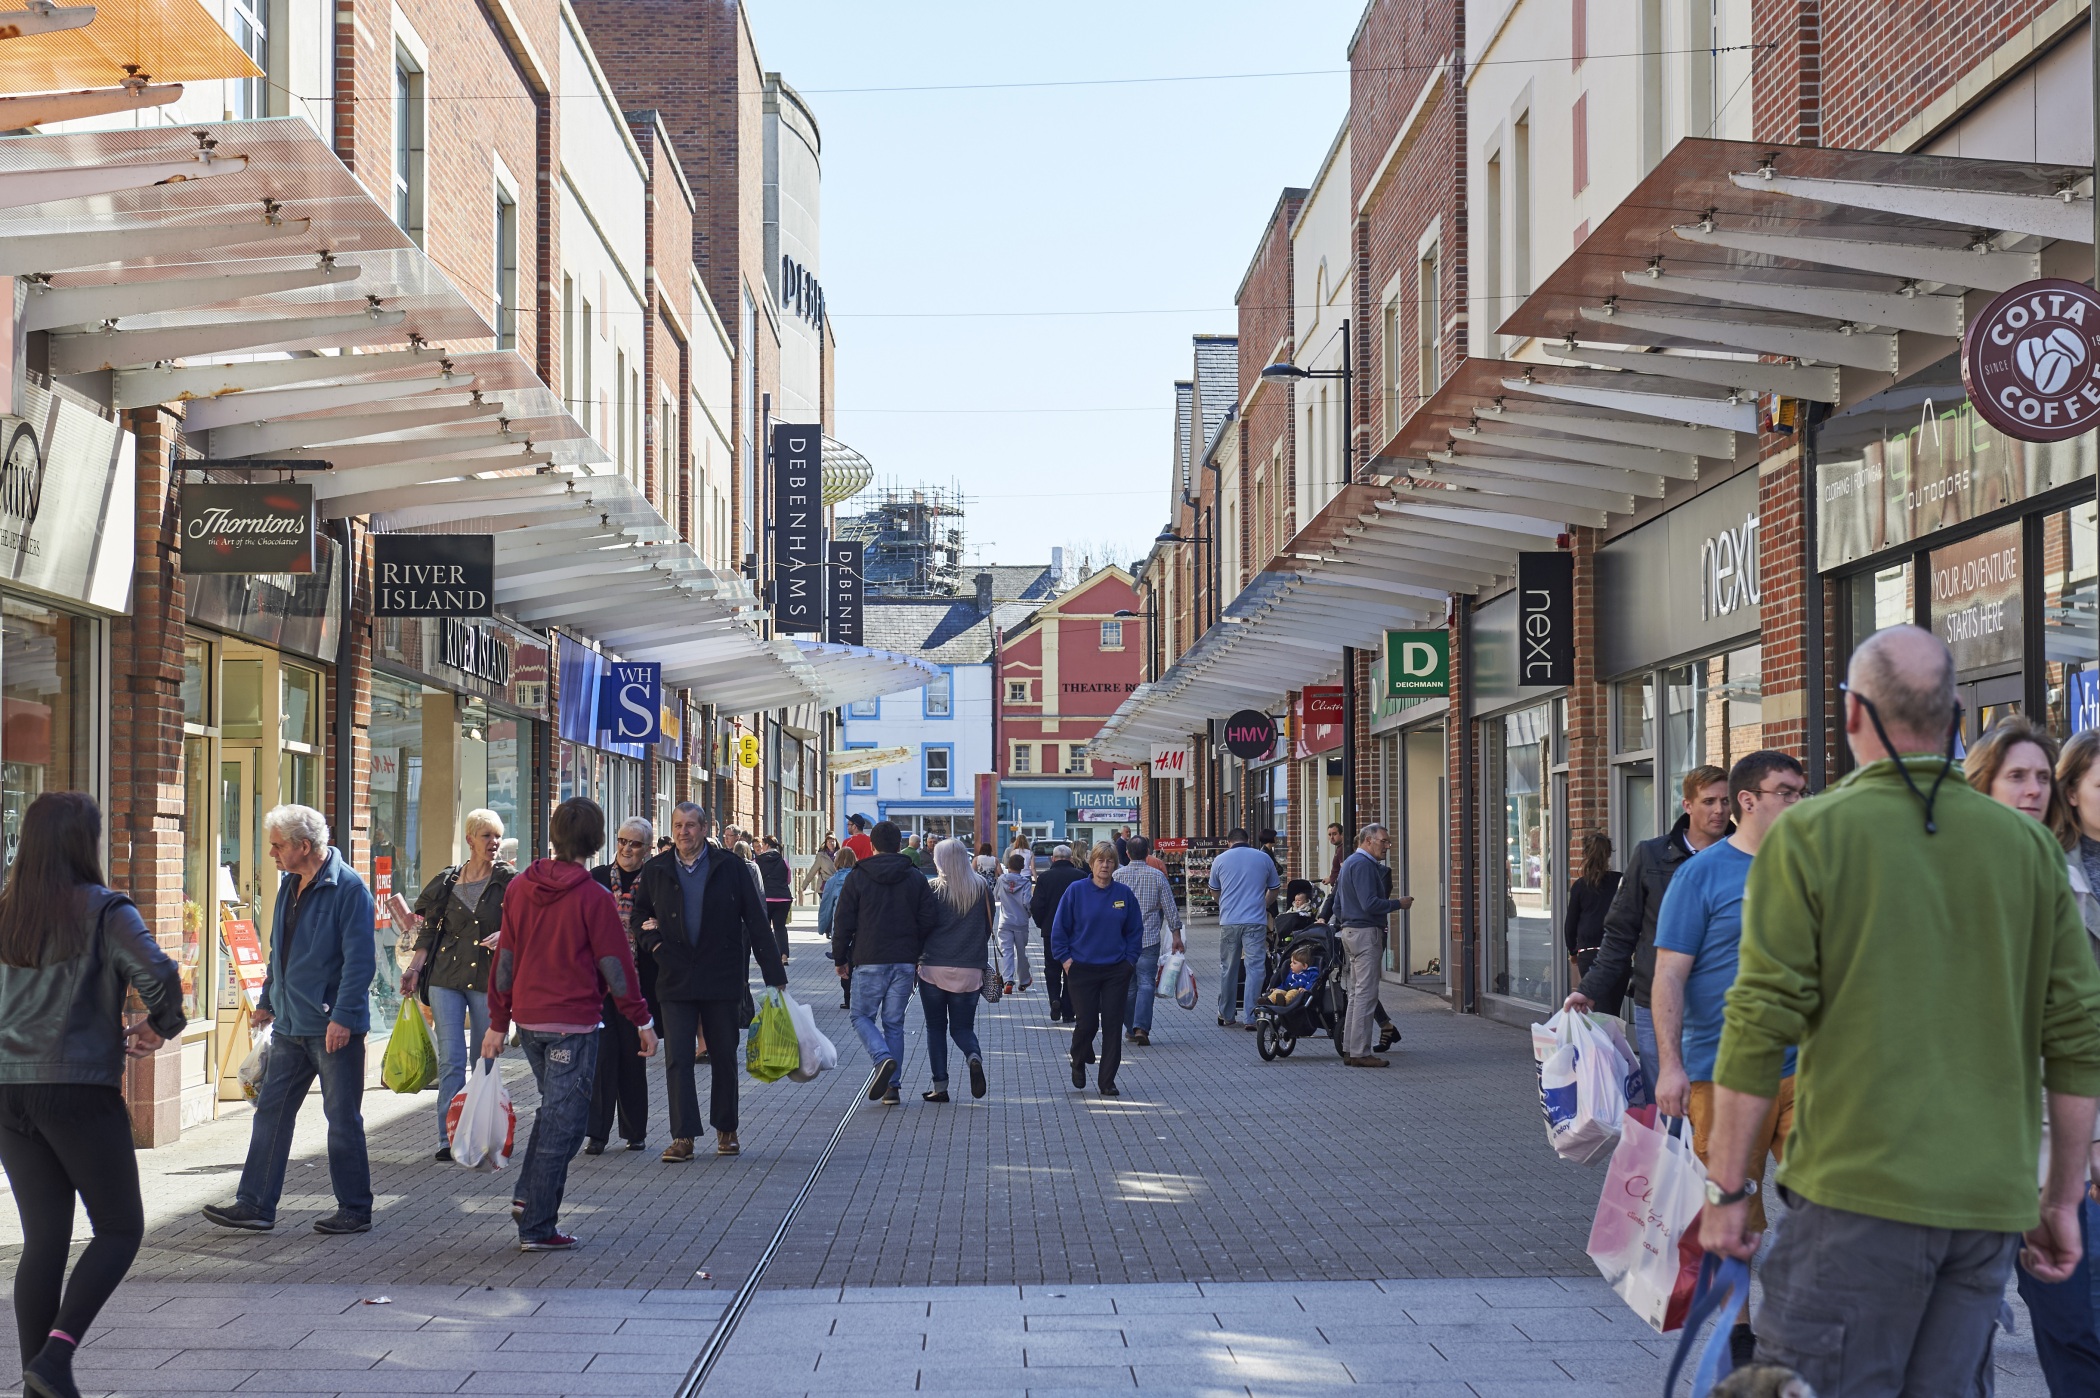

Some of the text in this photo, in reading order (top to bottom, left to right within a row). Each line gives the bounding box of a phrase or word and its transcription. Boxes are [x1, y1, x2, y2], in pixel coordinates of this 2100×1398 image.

[1991, 295, 2085, 345] COSTA
[1984, 359, 2009, 376] SINCE
[1826, 476, 1850, 502] CLOTHING
[1908, 469, 1969, 511] OUTDOORS
[188, 507, 305, 539] Thorntons
[789, 437, 807, 616] DEBENHAMS
[10, 532, 40, 557] JEWELLERS
[208, 536, 300, 549] the Art of the Chocolatier
[382, 563, 466, 585] RIVER
[1701, 512, 1761, 622] next
[1933, 547, 2017, 601] YOUR ADVENTURE
[382, 588, 486, 611] ISLAND
[1526, 589, 1551, 679] next
[1946, 601, 2004, 645] STARTS HERE
[447, 617, 510, 688] RIVER ISLAND
[1403, 642, 1438, 677] D
[617, 667, 652, 683] WH
[1062, 683, 1121, 693] THEATRE
[618, 683, 654, 738] S
[1228, 726, 1269, 742] HMV
[1155, 751, 1185, 770] H&M
[1117, 776, 1140, 791] H&M
[1072, 791, 1121, 807] THEATRE
